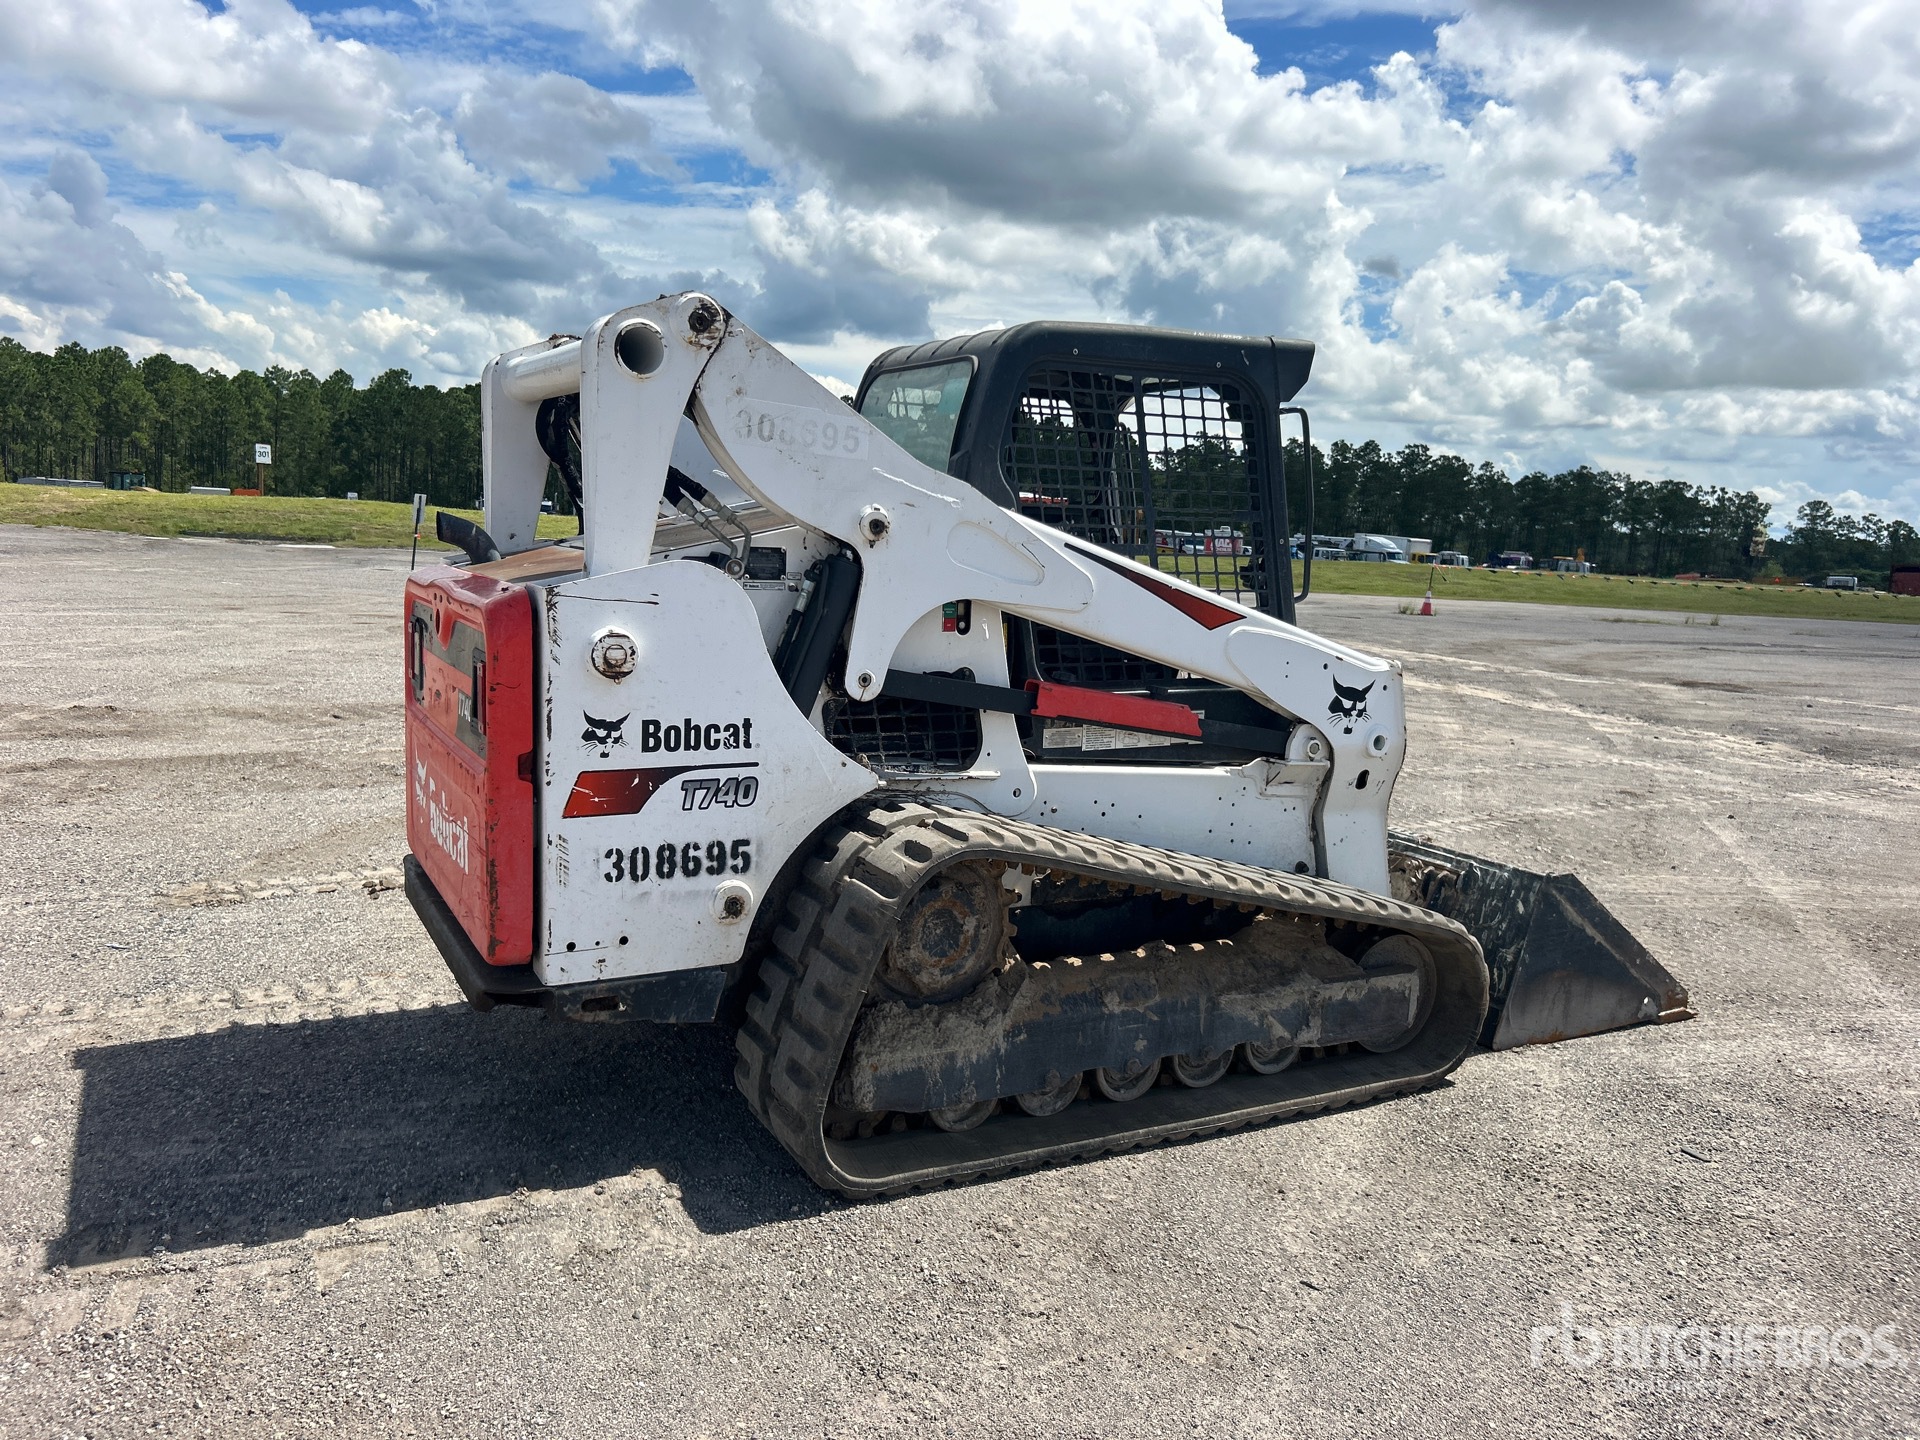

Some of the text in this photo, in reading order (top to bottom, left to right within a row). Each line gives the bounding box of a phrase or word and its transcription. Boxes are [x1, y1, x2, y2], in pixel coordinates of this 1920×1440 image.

[733, 409, 860, 454] 308695
[257, 450, 270, 458] 301
[641, 718, 753, 753] Bobcat
[681, 776, 759, 811] T740
[603, 839, 751, 883] 308695
